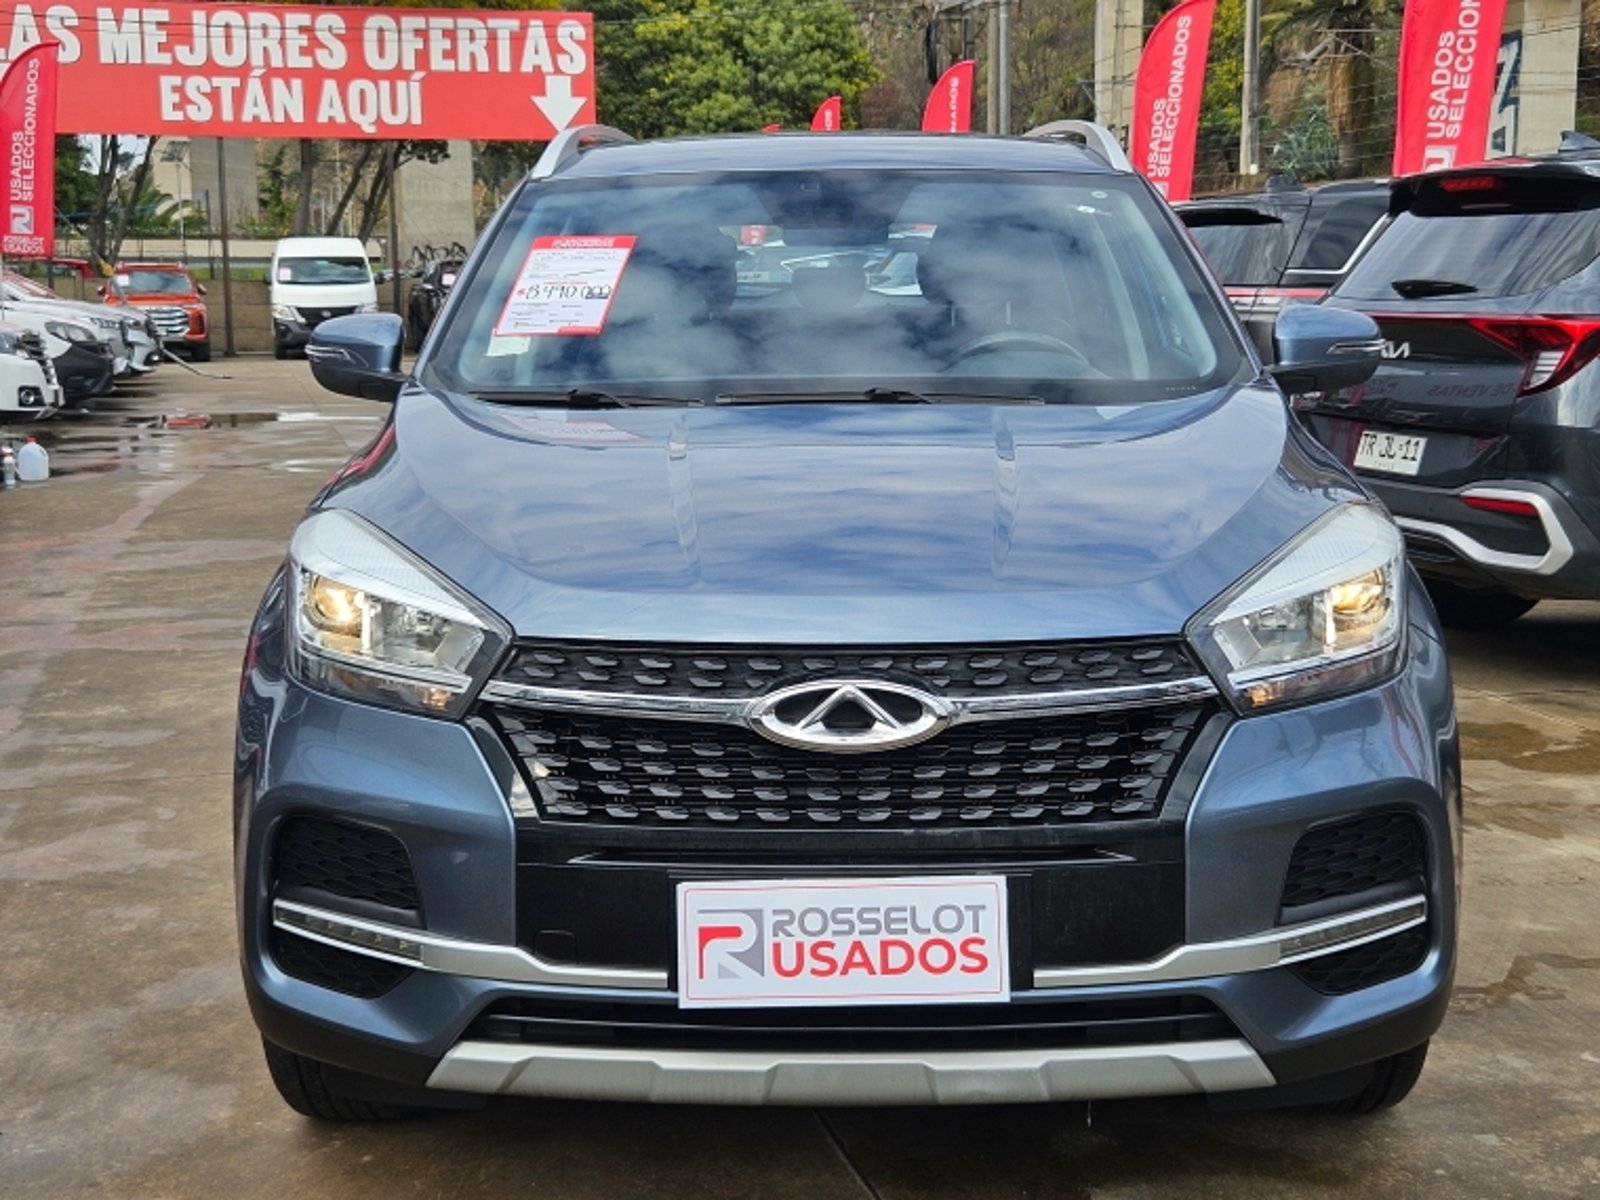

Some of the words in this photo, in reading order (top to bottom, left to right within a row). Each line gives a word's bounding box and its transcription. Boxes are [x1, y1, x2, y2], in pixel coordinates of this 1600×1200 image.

[0, 4, 80, 64] AS
[97, 7, 347, 69] MEJORES
[364, 15, 586, 75] OFERTAS
[160, 70, 305, 122] ESTÁN
[317, 72, 426, 133] AQUÍ
[1158, 15, 1192, 177] SELECCIONADOS
[1427, 31, 1456, 138] USADOS
[21, 58, 40, 202] SELECCIONADOS
[1148, 98, 1166, 178] USADOS
[11, 131, 24, 201] USADOS
[772, 905, 987, 938] ROSSELOT
[772, 937, 989, 978] USADOS
